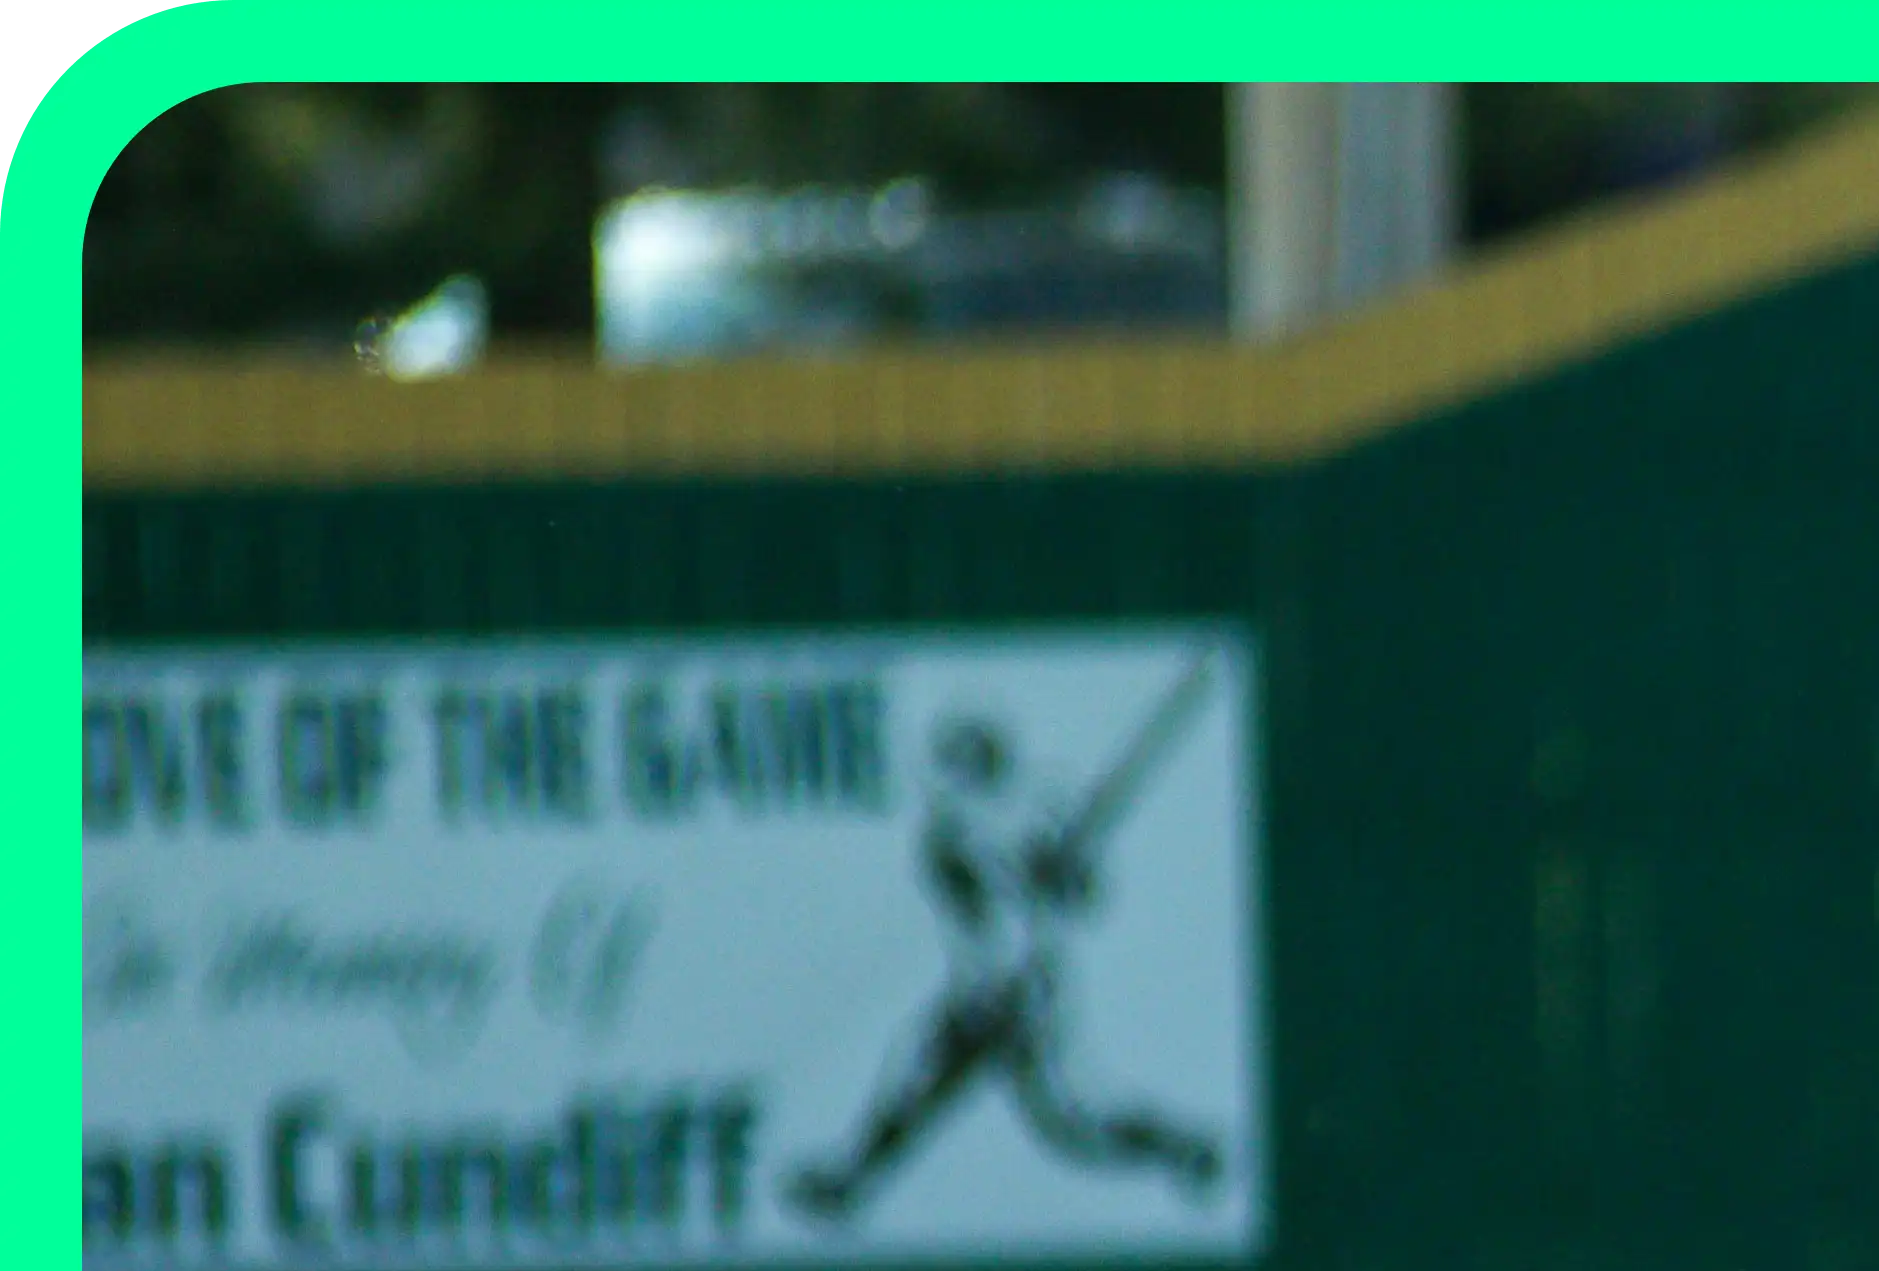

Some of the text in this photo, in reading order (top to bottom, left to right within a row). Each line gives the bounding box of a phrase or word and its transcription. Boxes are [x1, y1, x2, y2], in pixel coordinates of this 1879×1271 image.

[277, 686, 389, 830] OF
[432, 684, 594, 826] THE
[617, 680, 890, 822] GAME
[266, 1092, 752, 1250] Cundiff
